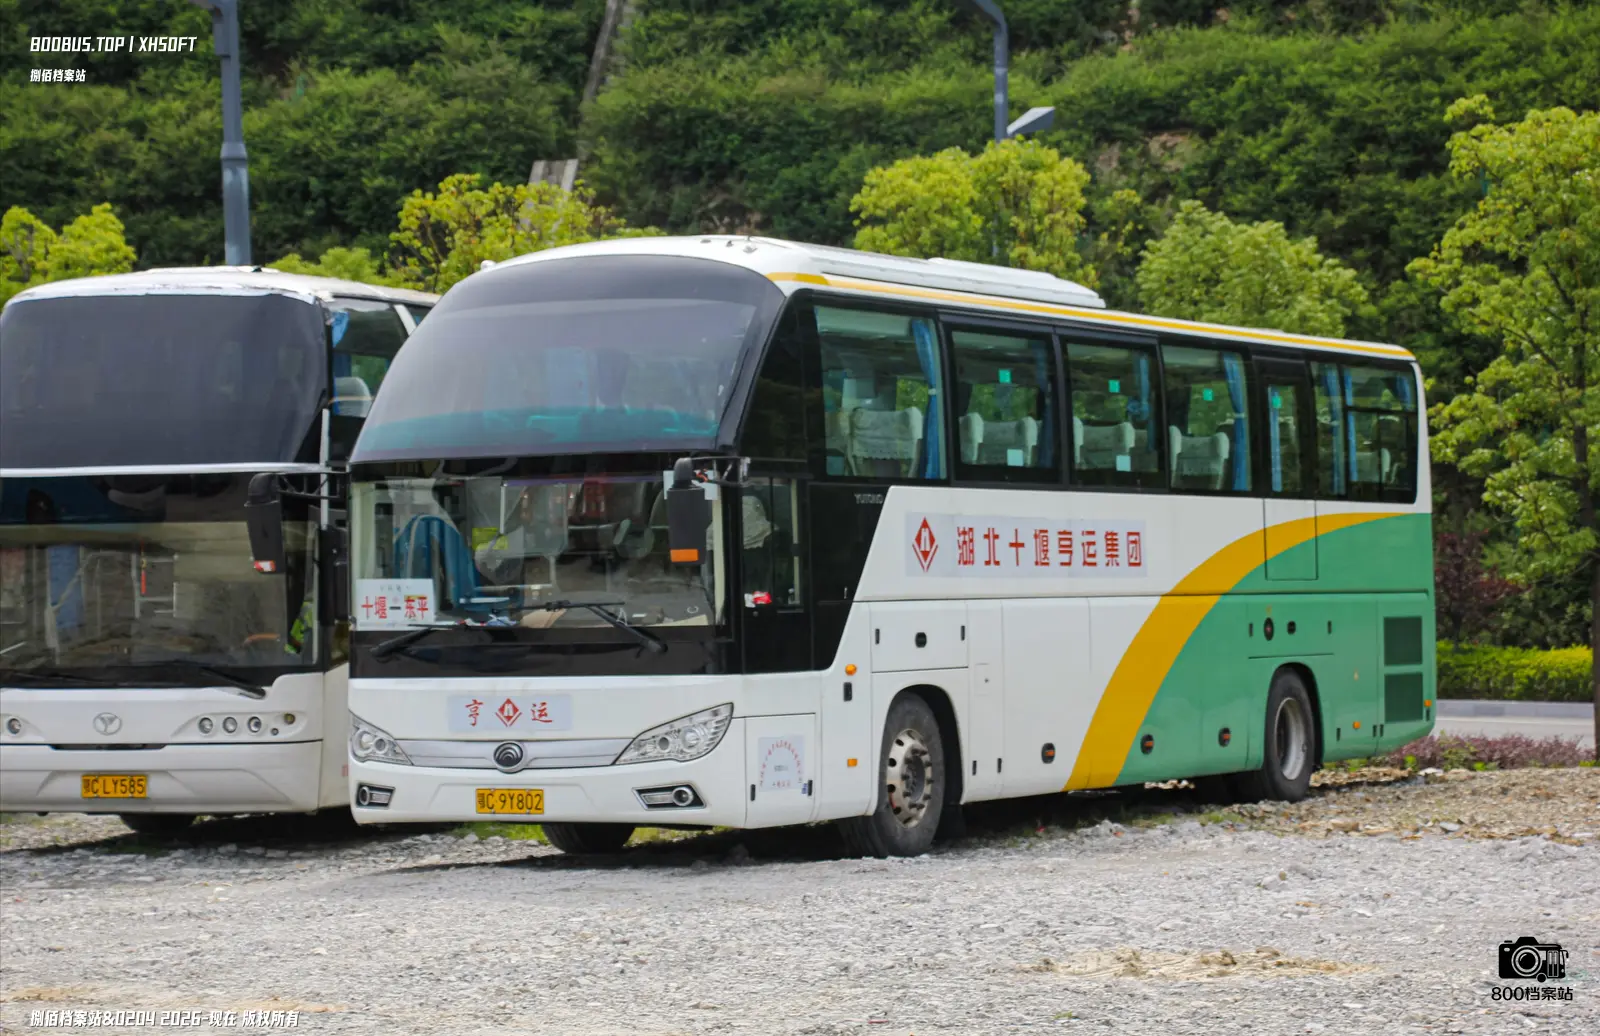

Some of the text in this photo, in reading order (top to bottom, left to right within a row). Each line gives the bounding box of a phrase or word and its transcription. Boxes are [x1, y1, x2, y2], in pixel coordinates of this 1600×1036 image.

[956, 526, 1143, 568] 湖北十堰亨运集团
[530, 701, 553, 724] 运
